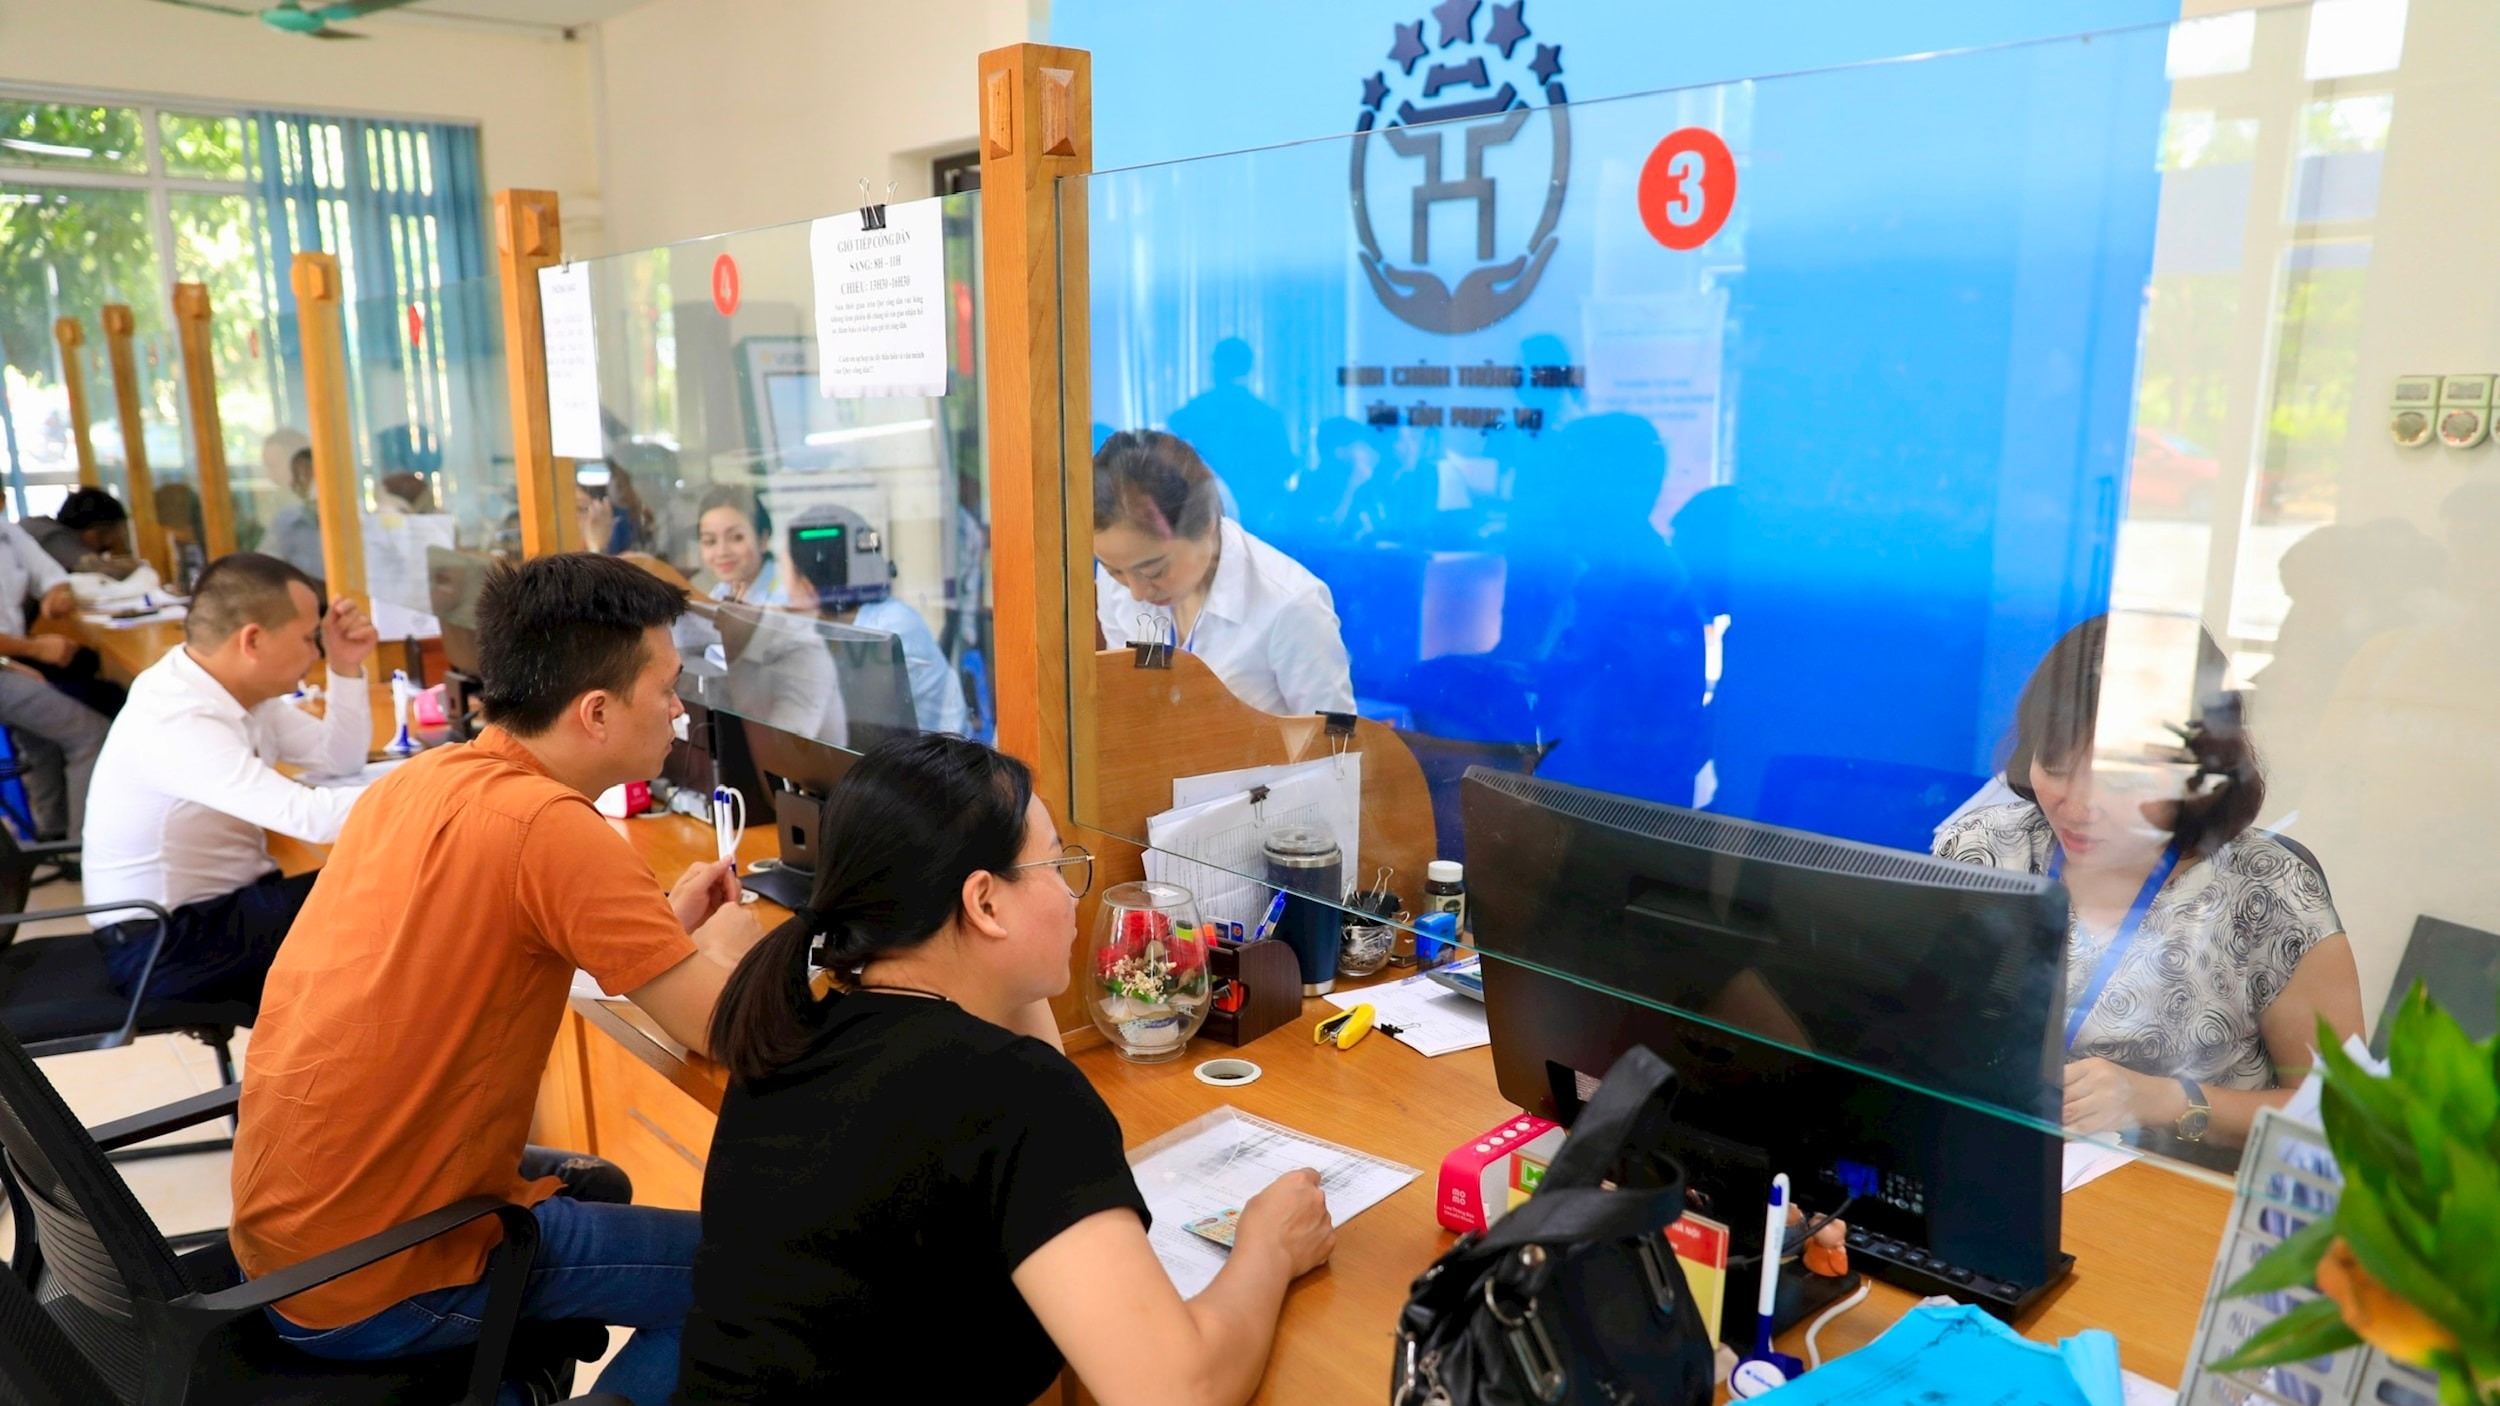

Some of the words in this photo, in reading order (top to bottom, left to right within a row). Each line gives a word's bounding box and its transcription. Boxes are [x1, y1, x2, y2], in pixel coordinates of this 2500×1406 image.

[1666, 150, 1705, 227] 3
[873, 232, 894, 248] CÔNG
[874, 257, 883, 269] 8H
[890, 255, 901, 267] 11H
[870, 278, 888, 291] 13H30
